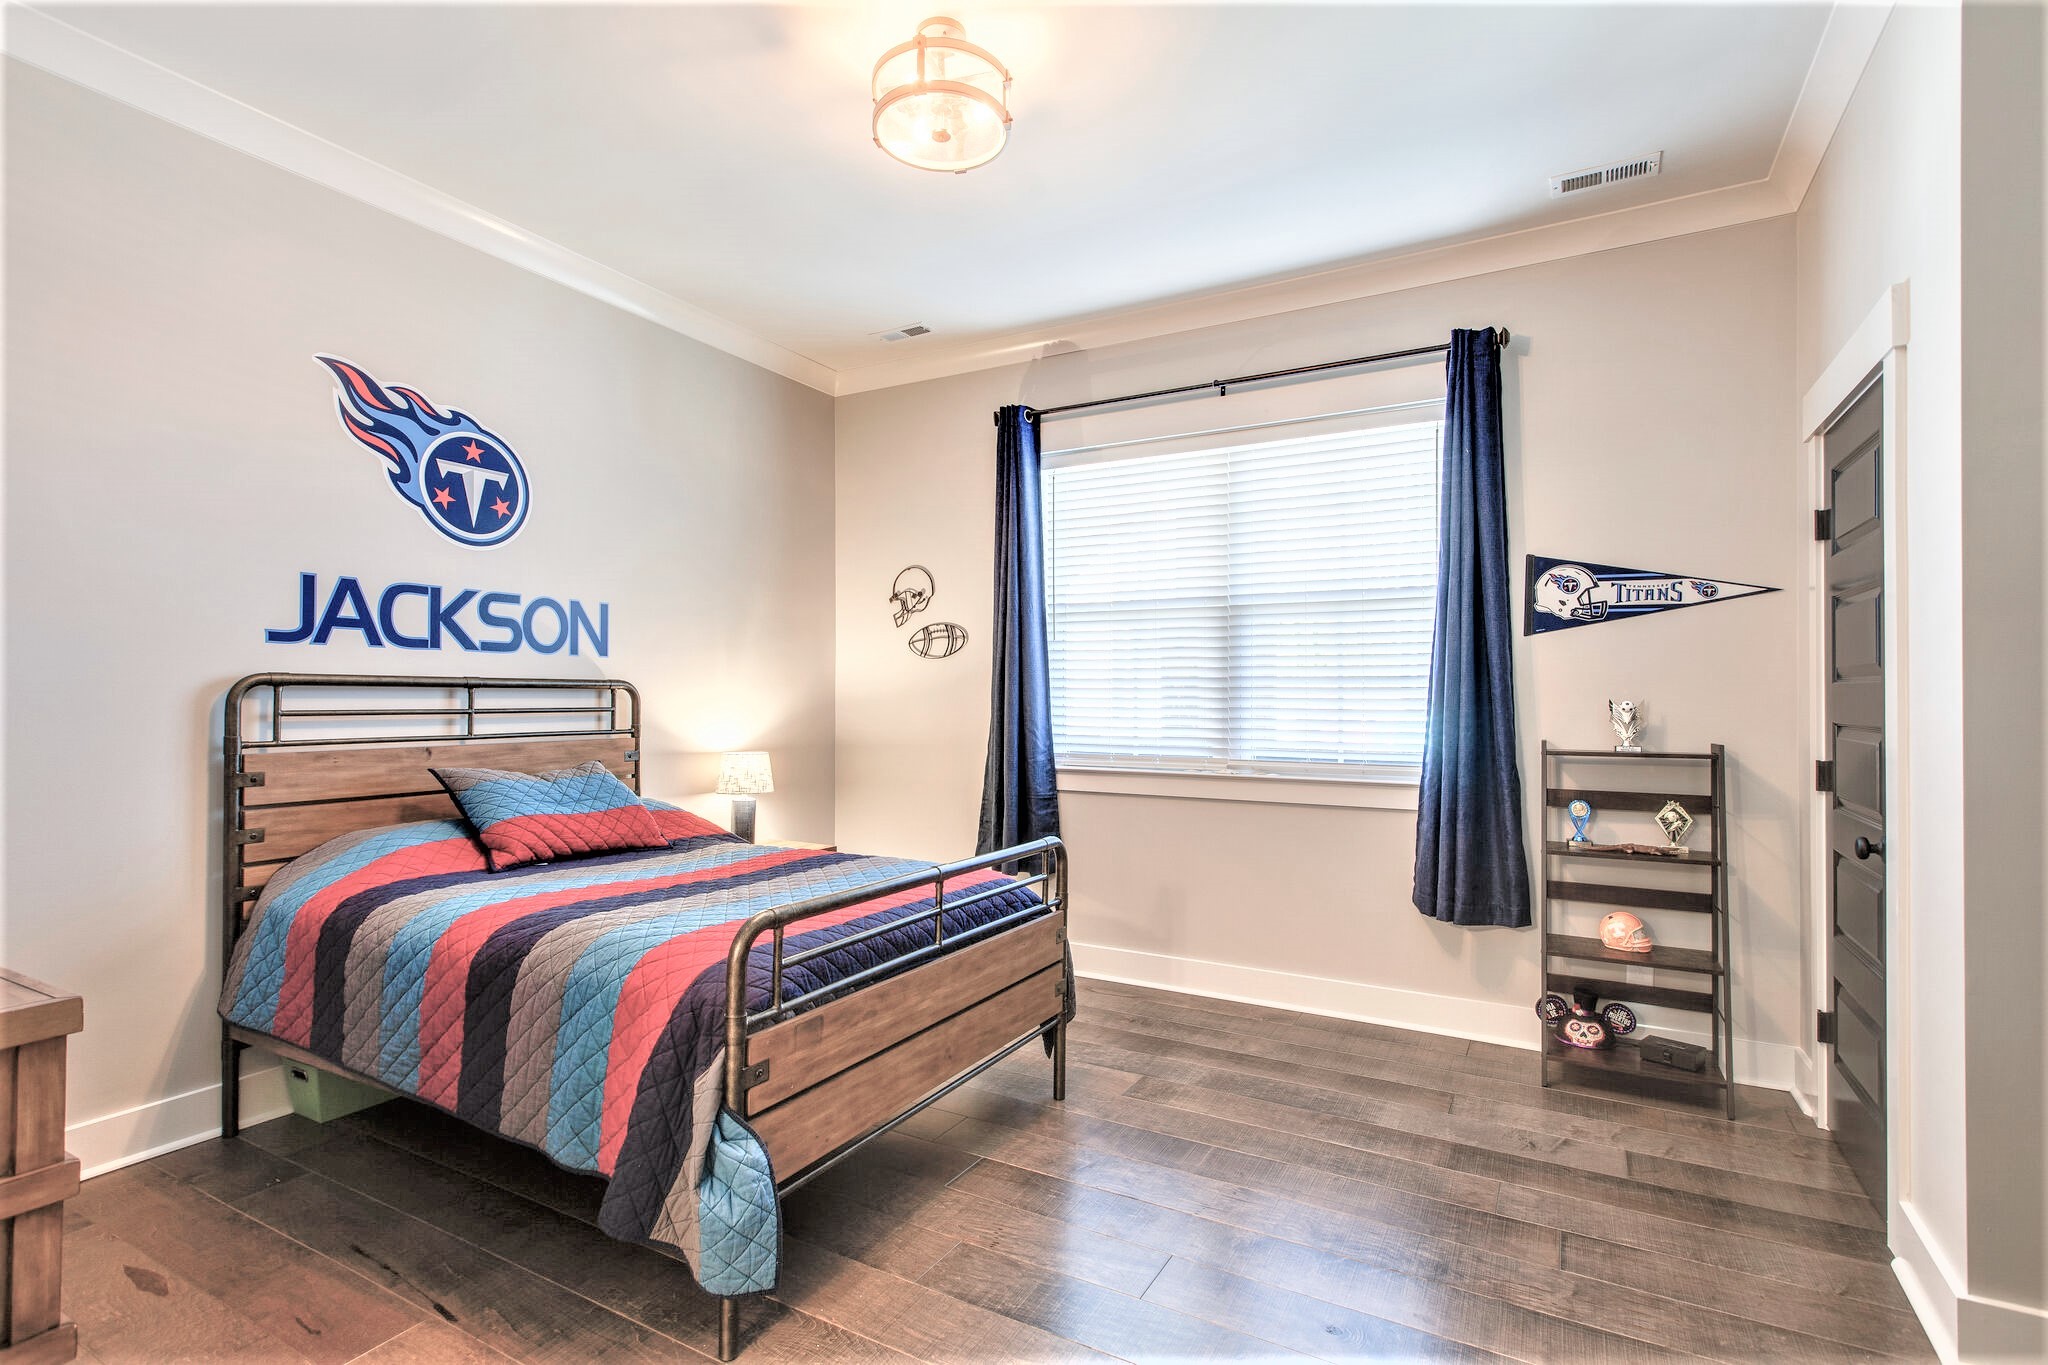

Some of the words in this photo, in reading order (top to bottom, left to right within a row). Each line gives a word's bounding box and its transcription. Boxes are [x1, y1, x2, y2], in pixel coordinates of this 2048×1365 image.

[435, 457, 509, 529] T
[265, 571, 609, 658] JACKSON
[1611, 581, 1683, 603] TITANS
